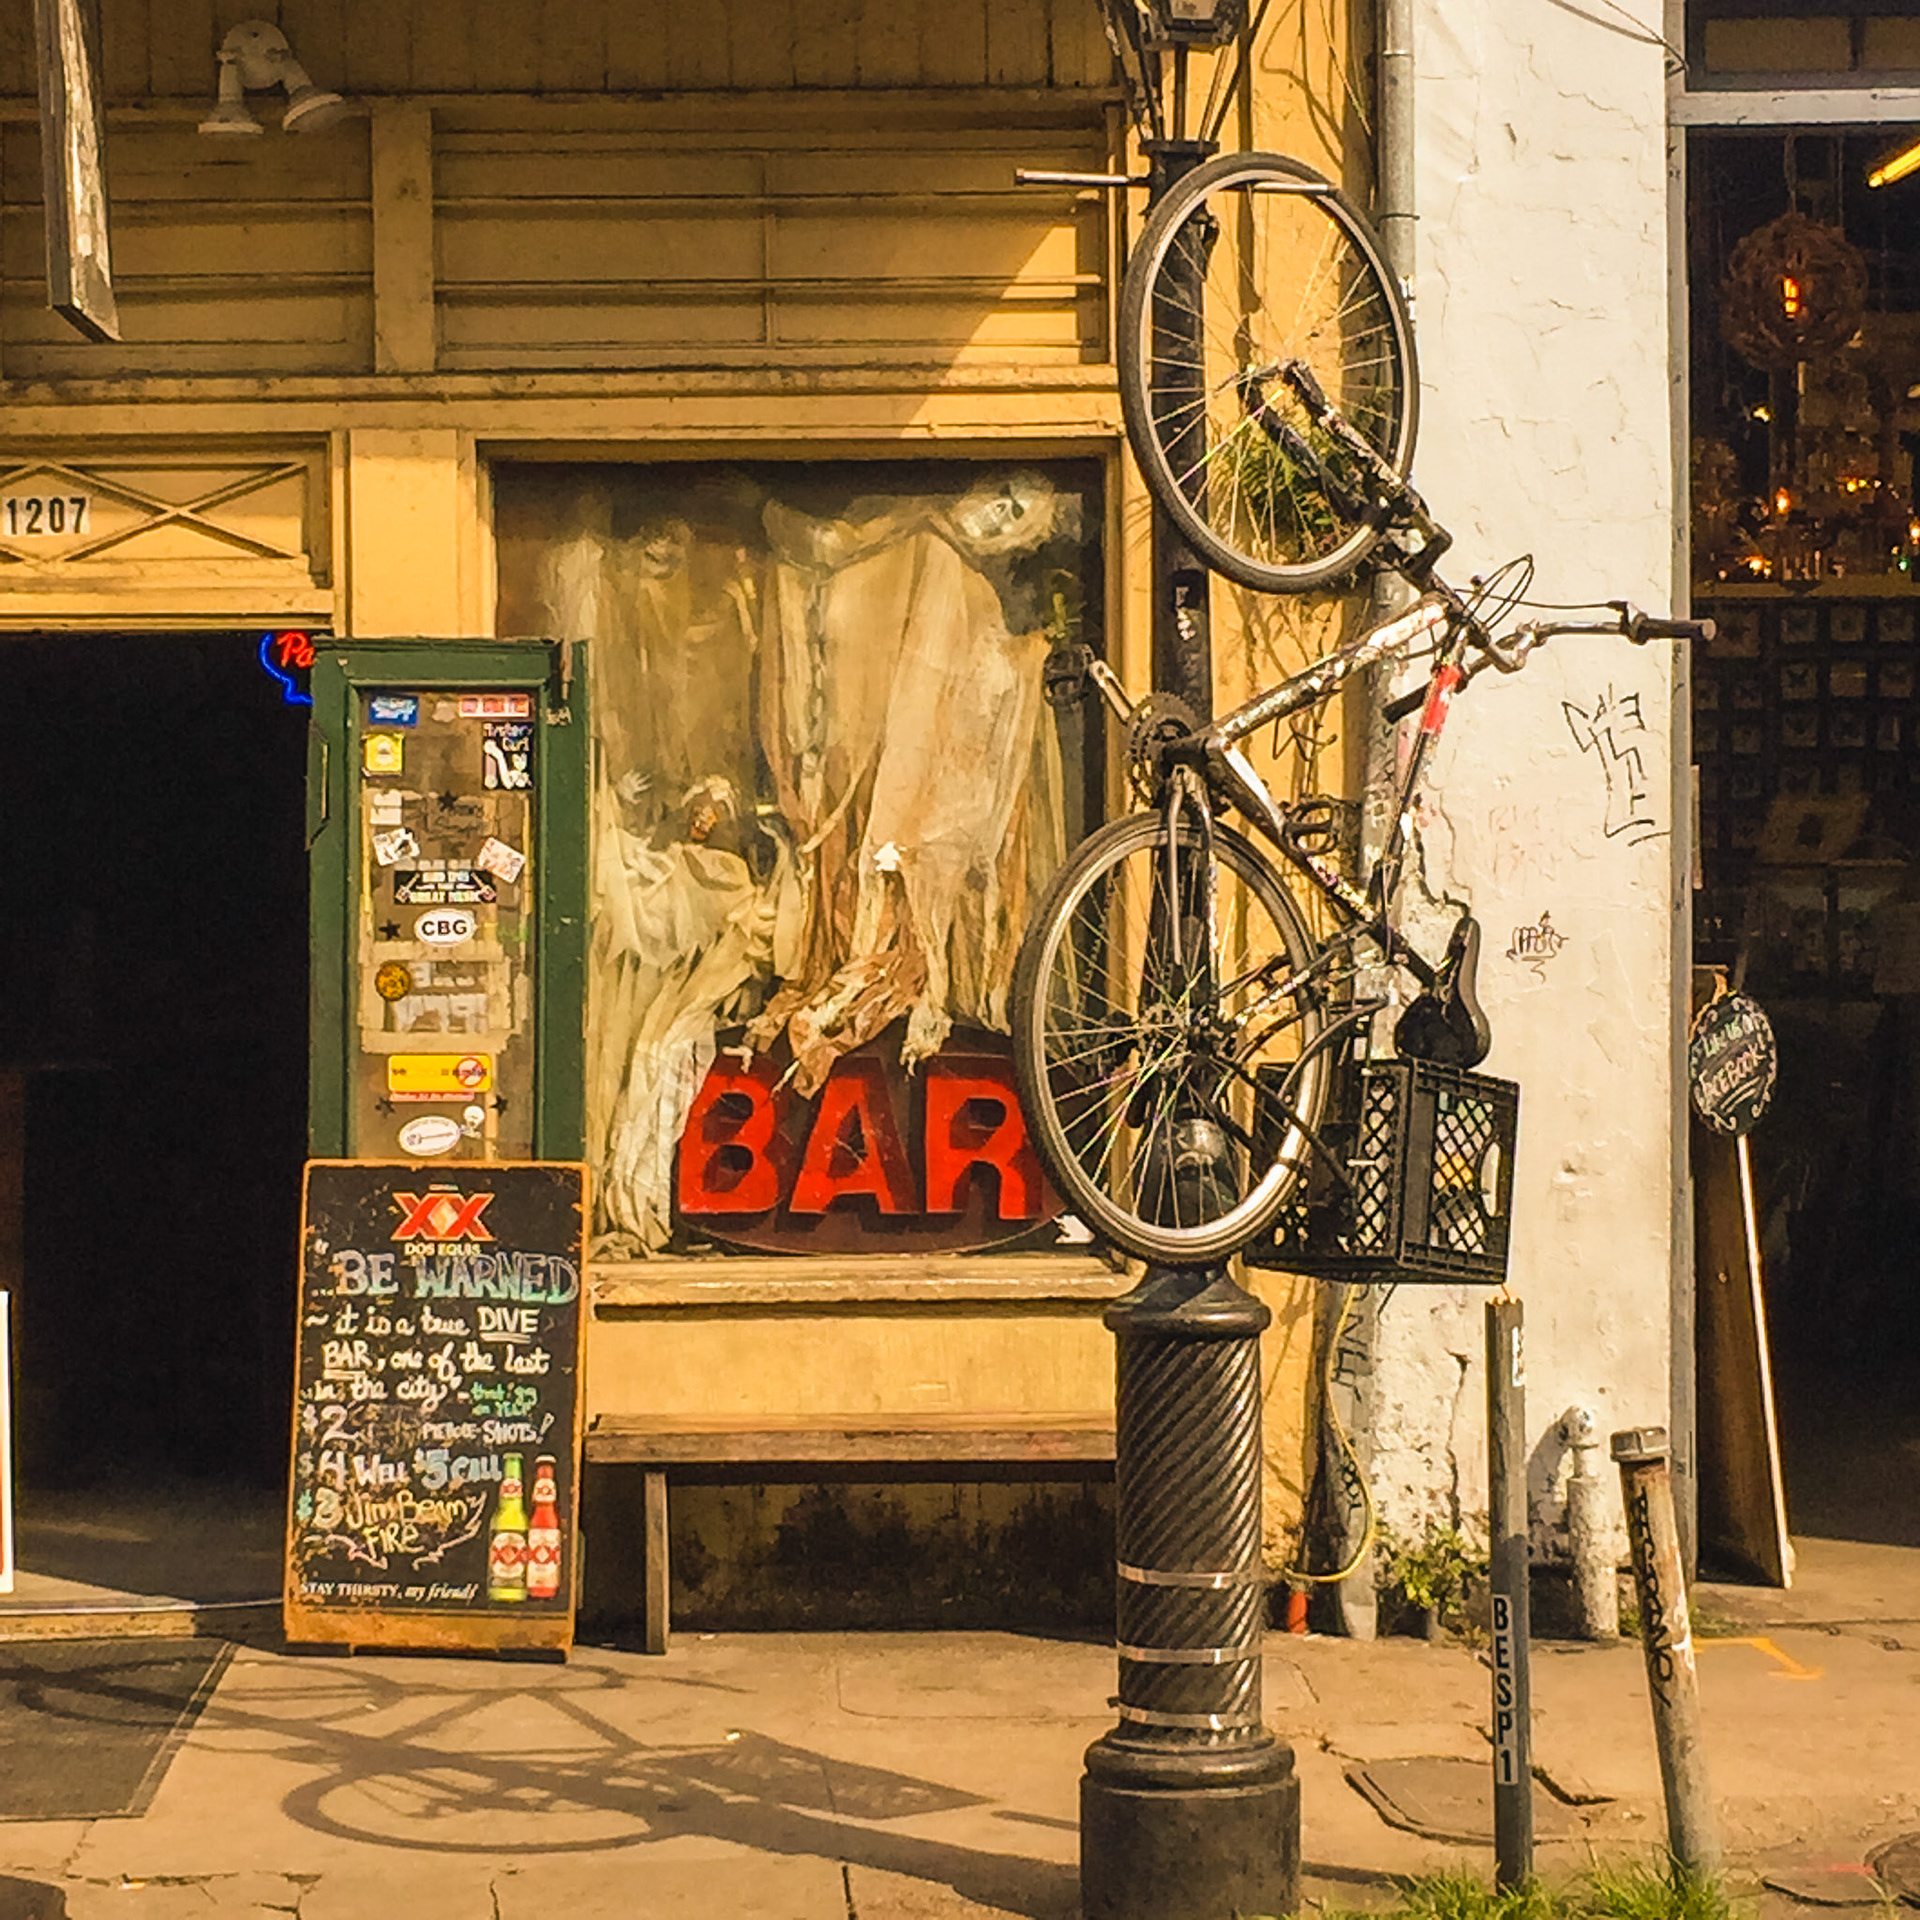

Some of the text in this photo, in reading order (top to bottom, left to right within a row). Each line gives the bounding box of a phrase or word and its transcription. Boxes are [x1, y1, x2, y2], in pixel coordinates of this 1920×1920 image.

[5, 498, 87, 535] 1207
[421, 919, 468, 936] CBG
[678, 1068, 1045, 1220] BAR
[390, 1192, 496, 1241] XX
[404, 1243, 481, 1256] DOS EQUIS
[333, 1249, 580, 1305] BE WARNED
[335, 1303, 360, 1335] it
[395, 1318, 416, 1336] a
[476, 1306, 541, 1334] DIVE
[389, 1350, 424, 1369] one
[427, 1341, 457, 1381] of
[459, 1341, 496, 1374] the
[350, 1373, 390, 1401] the
[300, 1581, 336, 1596] STAY
[404, 1585, 427, 1602] my
[1493, 1597, 1513, 1783] BESP1
